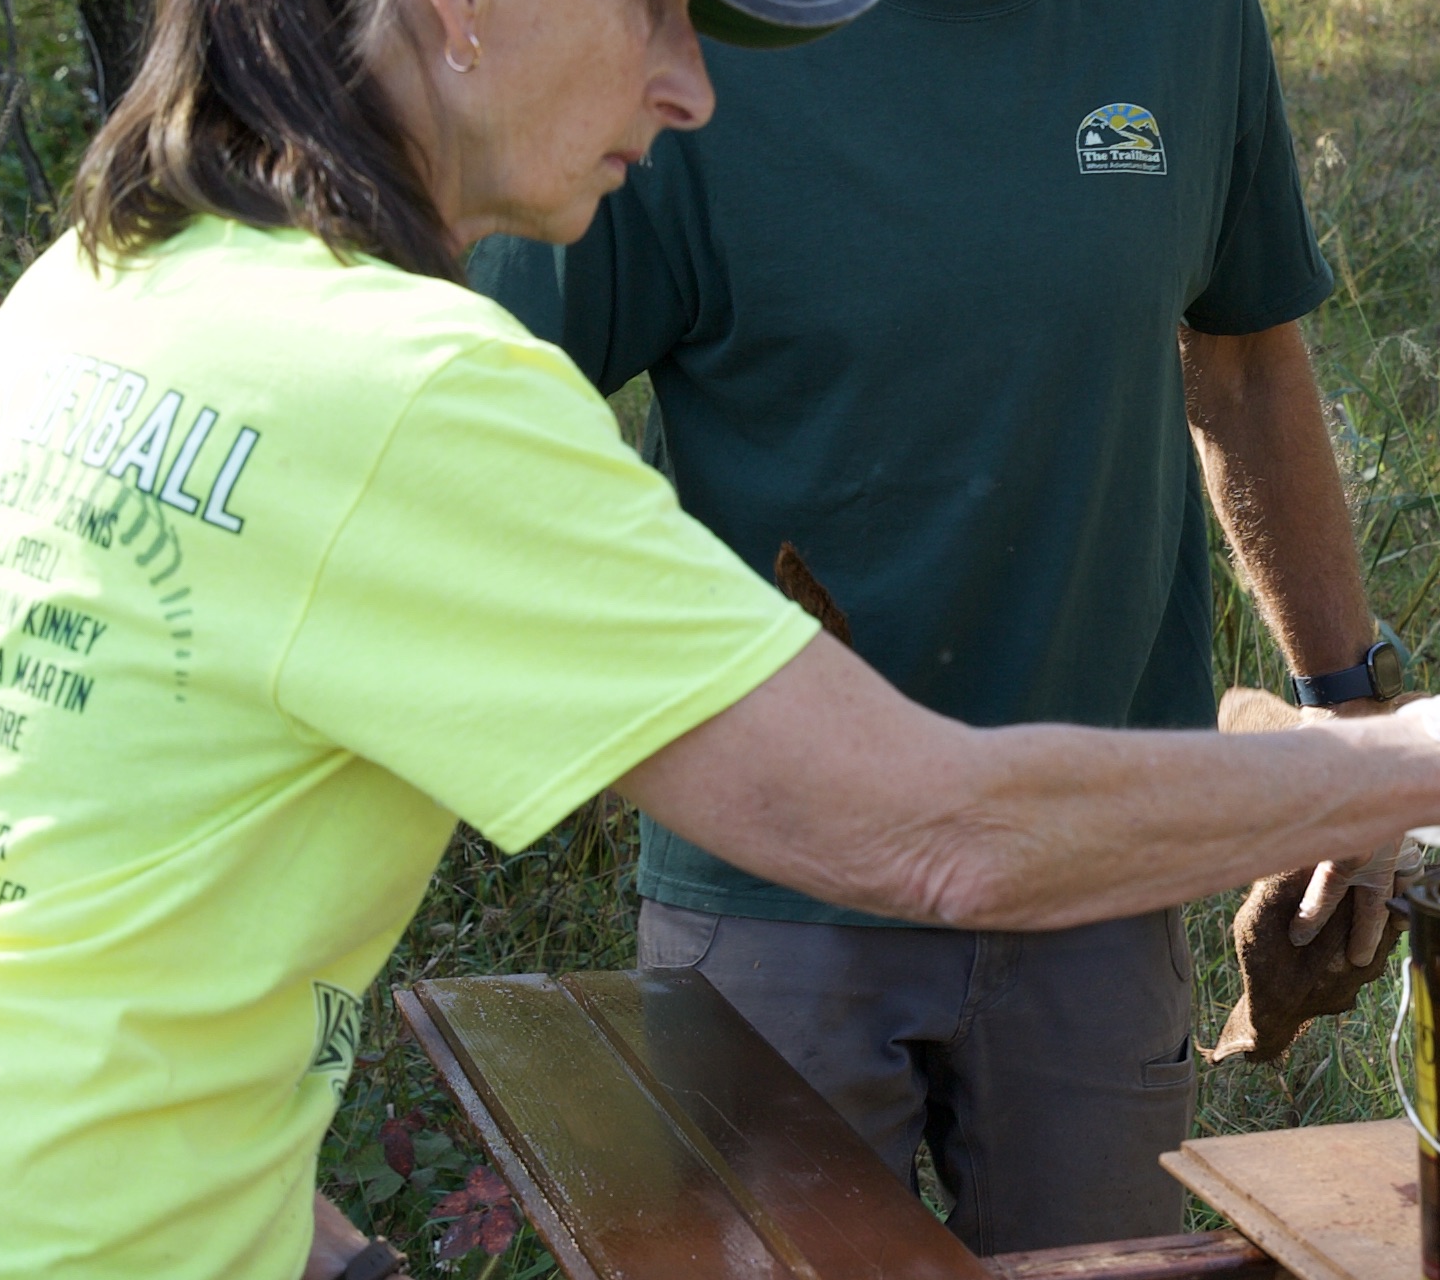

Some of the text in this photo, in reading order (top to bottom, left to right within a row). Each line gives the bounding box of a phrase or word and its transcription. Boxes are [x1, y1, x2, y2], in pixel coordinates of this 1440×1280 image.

[1083, 150, 1161, 163] The Trailhead
[21, 600, 108, 656] KINNEY
[11, 652, 95, 715] MARTIN
